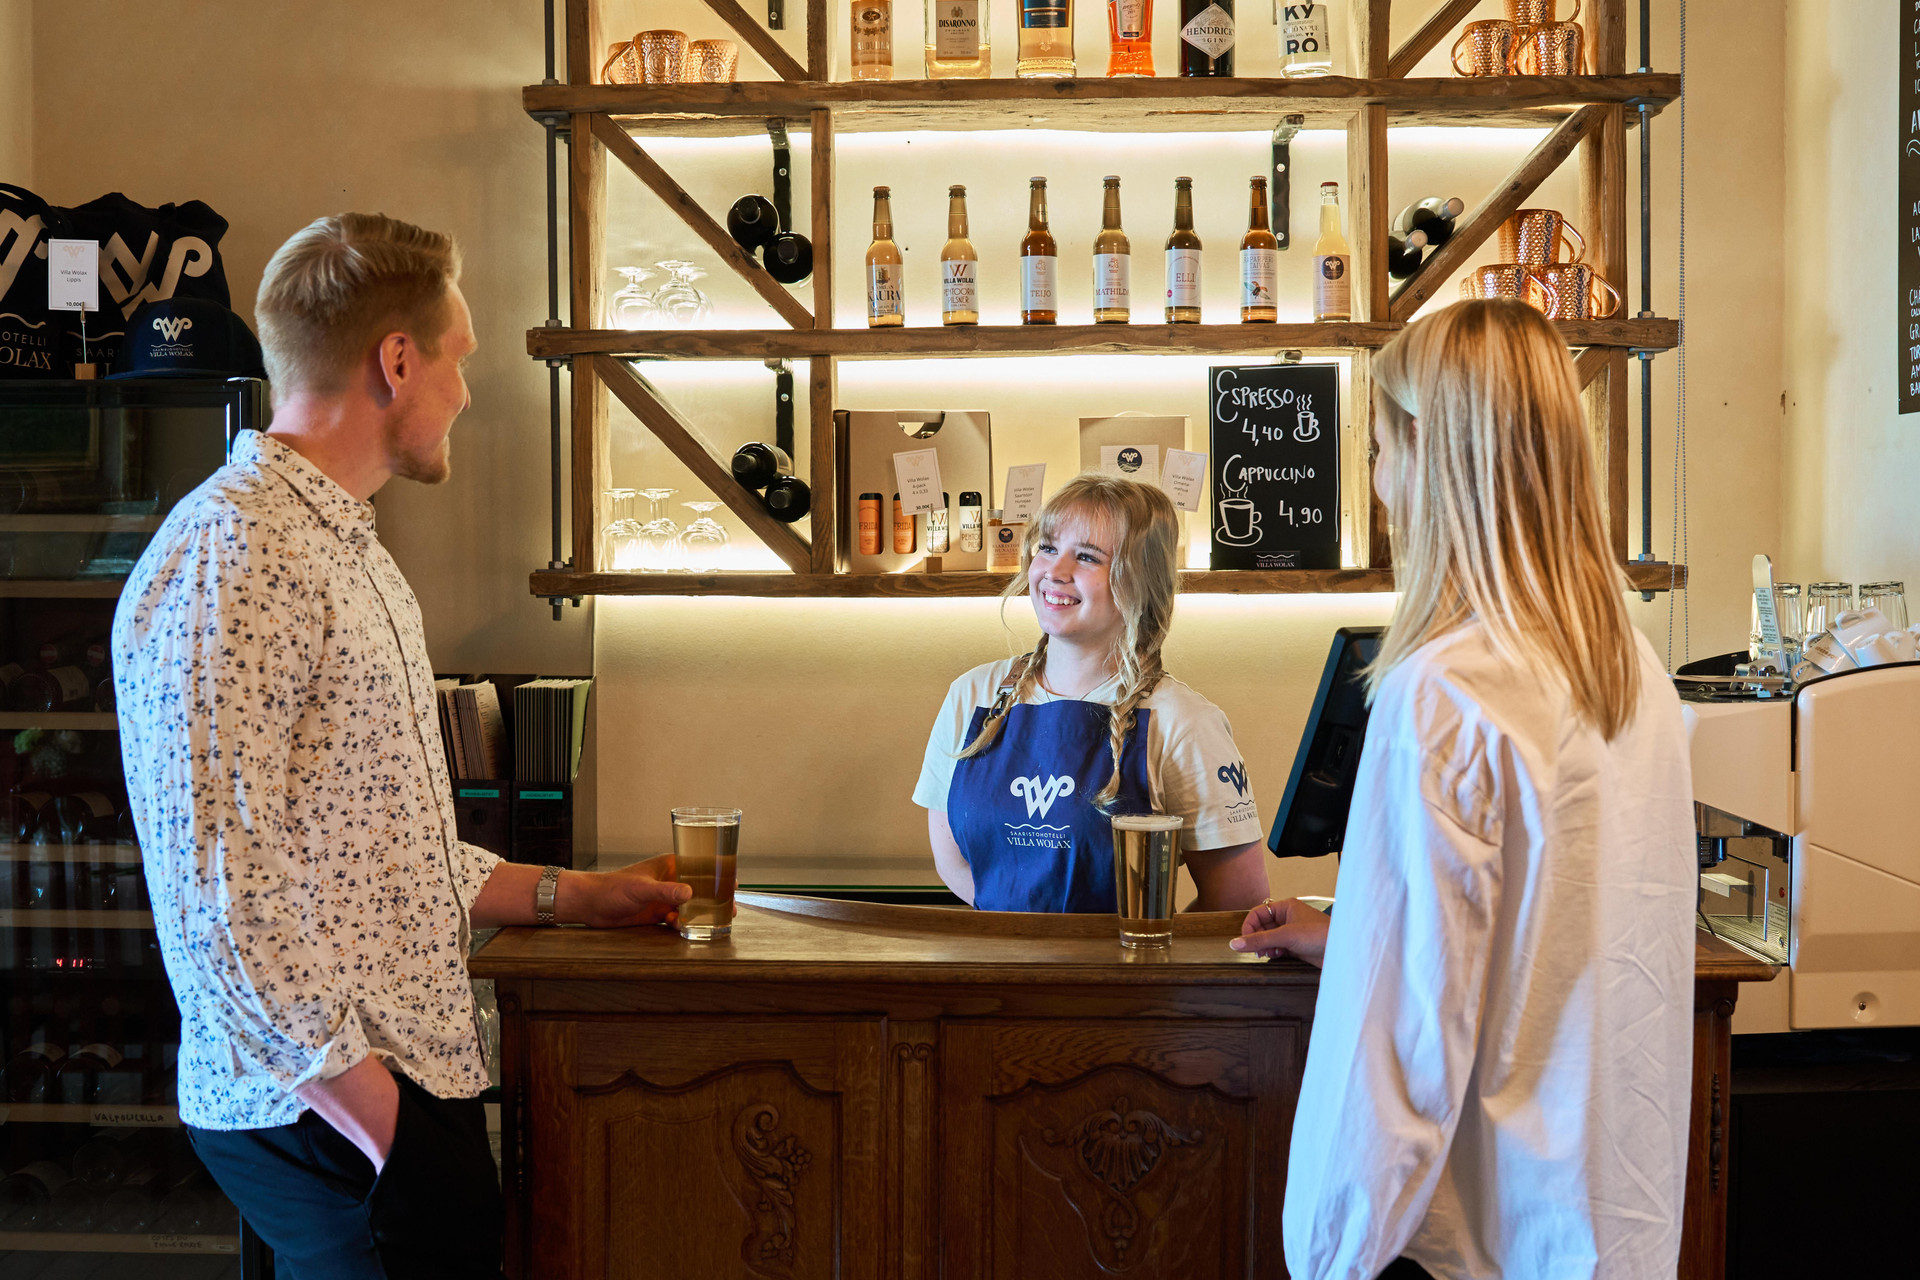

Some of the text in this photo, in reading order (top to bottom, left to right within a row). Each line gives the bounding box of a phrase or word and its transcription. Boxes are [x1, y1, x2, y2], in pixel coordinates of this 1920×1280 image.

[938, 19, 976, 28] DISARONNO
[1175, 272, 1196, 283] ELLI
[1031, 289, 1052, 298] TEIJO
[1227, 814, 1248, 824] VILLA
[1010, 831, 1066, 839] SAARISTOHOTELLI
[1007, 837, 1072, 849] VILLA WOLAX
